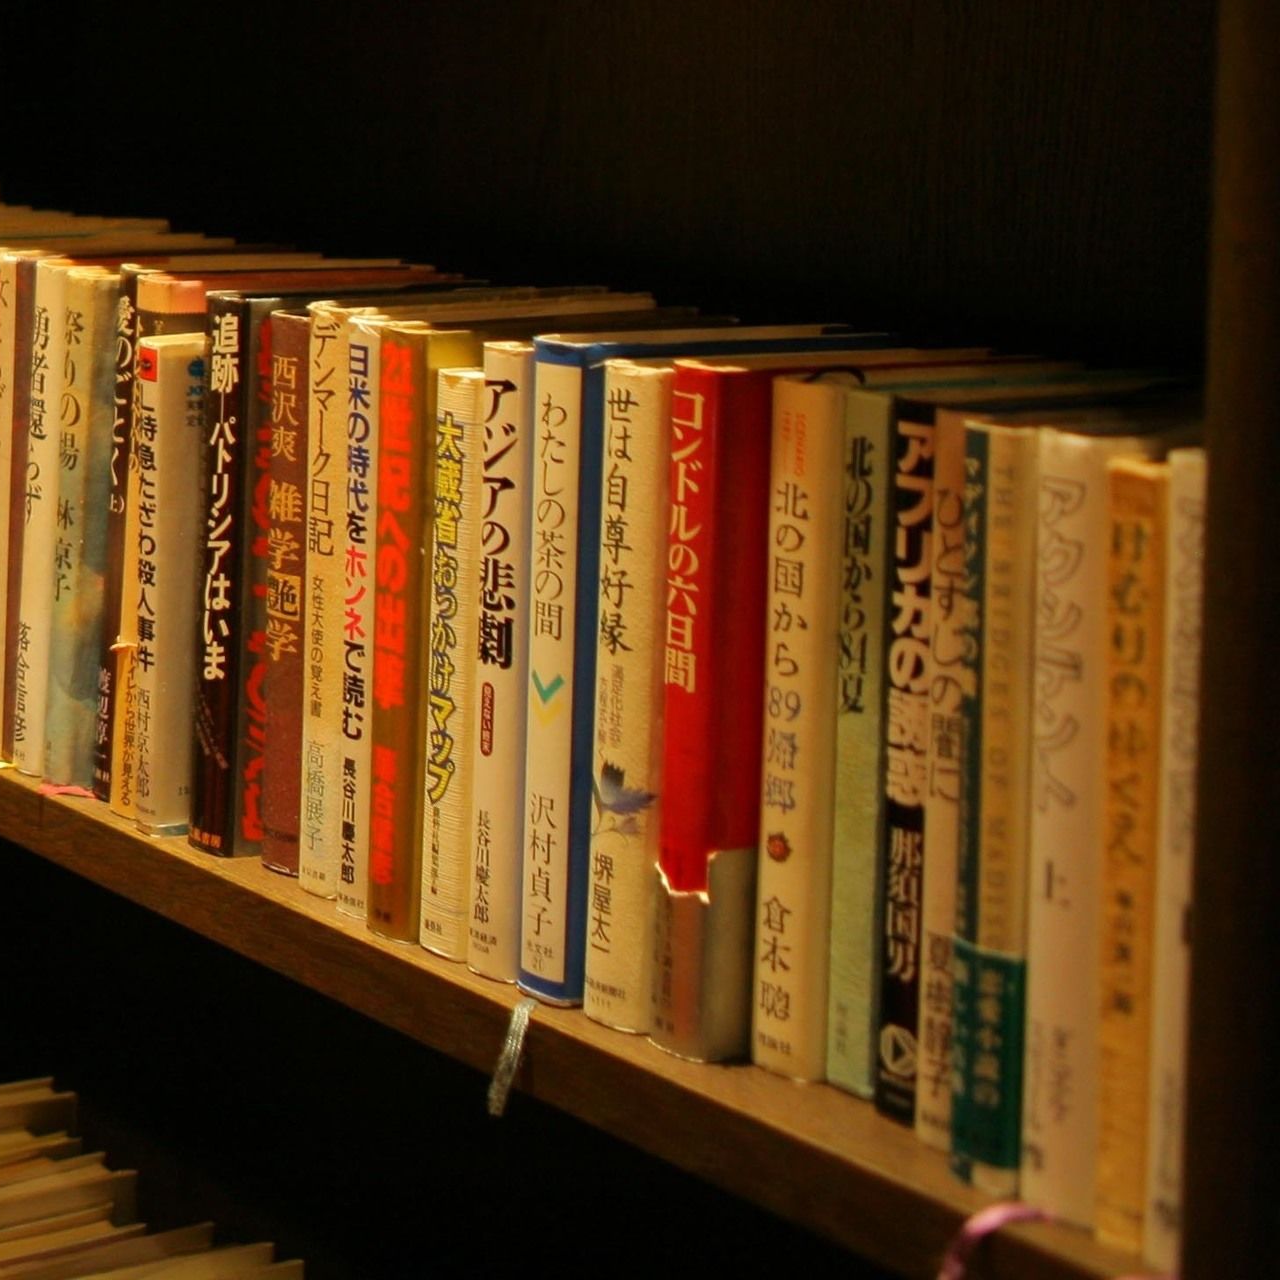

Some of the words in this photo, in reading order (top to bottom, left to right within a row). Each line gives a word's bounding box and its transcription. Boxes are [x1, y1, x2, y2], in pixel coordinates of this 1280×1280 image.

[59, 308, 84, 470] 祭りの場
[110, 295, 136, 487] 愛のごとく
[271, 356, 299, 462] 西沢爽
[308, 321, 341, 556] デンマーク日記
[54, 494, 74, 601] 林京子
[342, 342, 372, 740] 日米の時代をホンネで読む
[477, 379, 519, 669] アジアの悲劇
[534, 393, 569, 641] わたしの茶の間
[600, 388, 641, 655] 世は自尊好縁
[663, 389, 706, 694] コンドルの六日間
[14, 620, 32, 743] 落合信彦
[311, 575, 326, 718] 女性大使の覚え書
[426, 410, 465, 805] 大蔵省おっかけマップ
[1033, 477, 1087, 817] アクシデント
[136, 689, 151, 799] 西村京太郎
[340, 756, 357, 884] 長谷川慶太郎
[474, 810, 491, 925] 長谷川慶太郎
[529, 792, 559, 936] 沢村貞子
[591, 851, 614, 955] 堺屋太一
